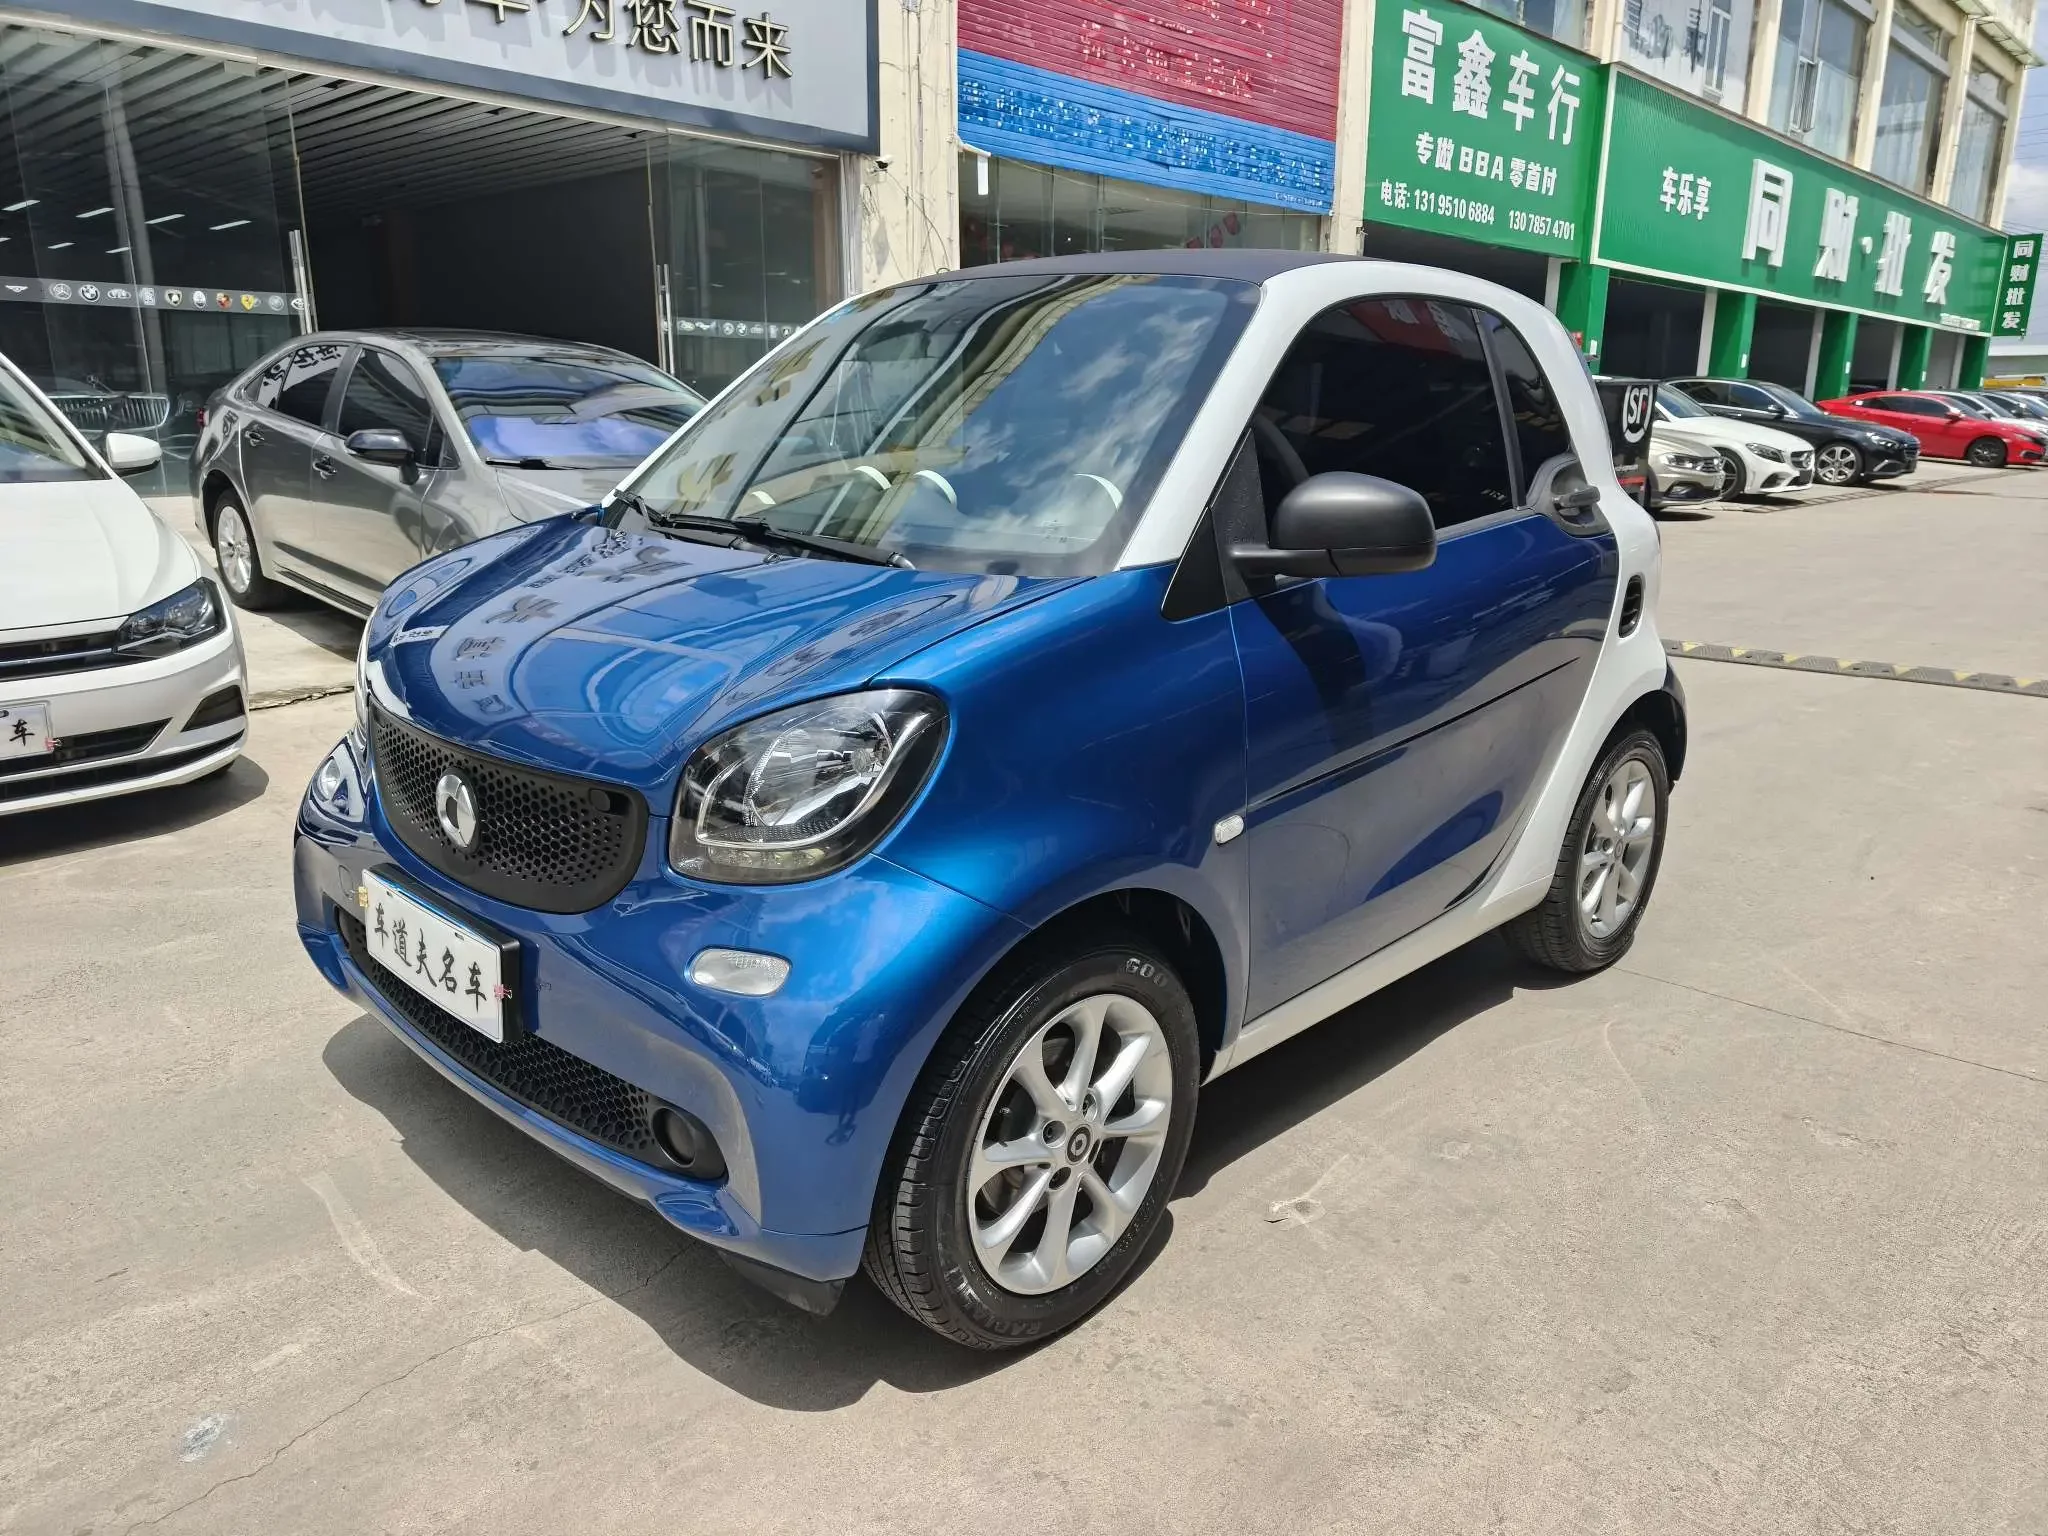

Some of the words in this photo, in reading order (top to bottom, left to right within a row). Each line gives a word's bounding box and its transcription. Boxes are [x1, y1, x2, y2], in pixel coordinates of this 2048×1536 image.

[1402, 9, 1581, 145] 富鑫车行
[1458, 146, 1504, 181] BBA
[1414, 188, 1435, 213] 131
[1437, 194, 1467, 219] 9510
[1468, 200, 1495, 225] 6884
[1659, 165, 1712, 220] 车乐享
